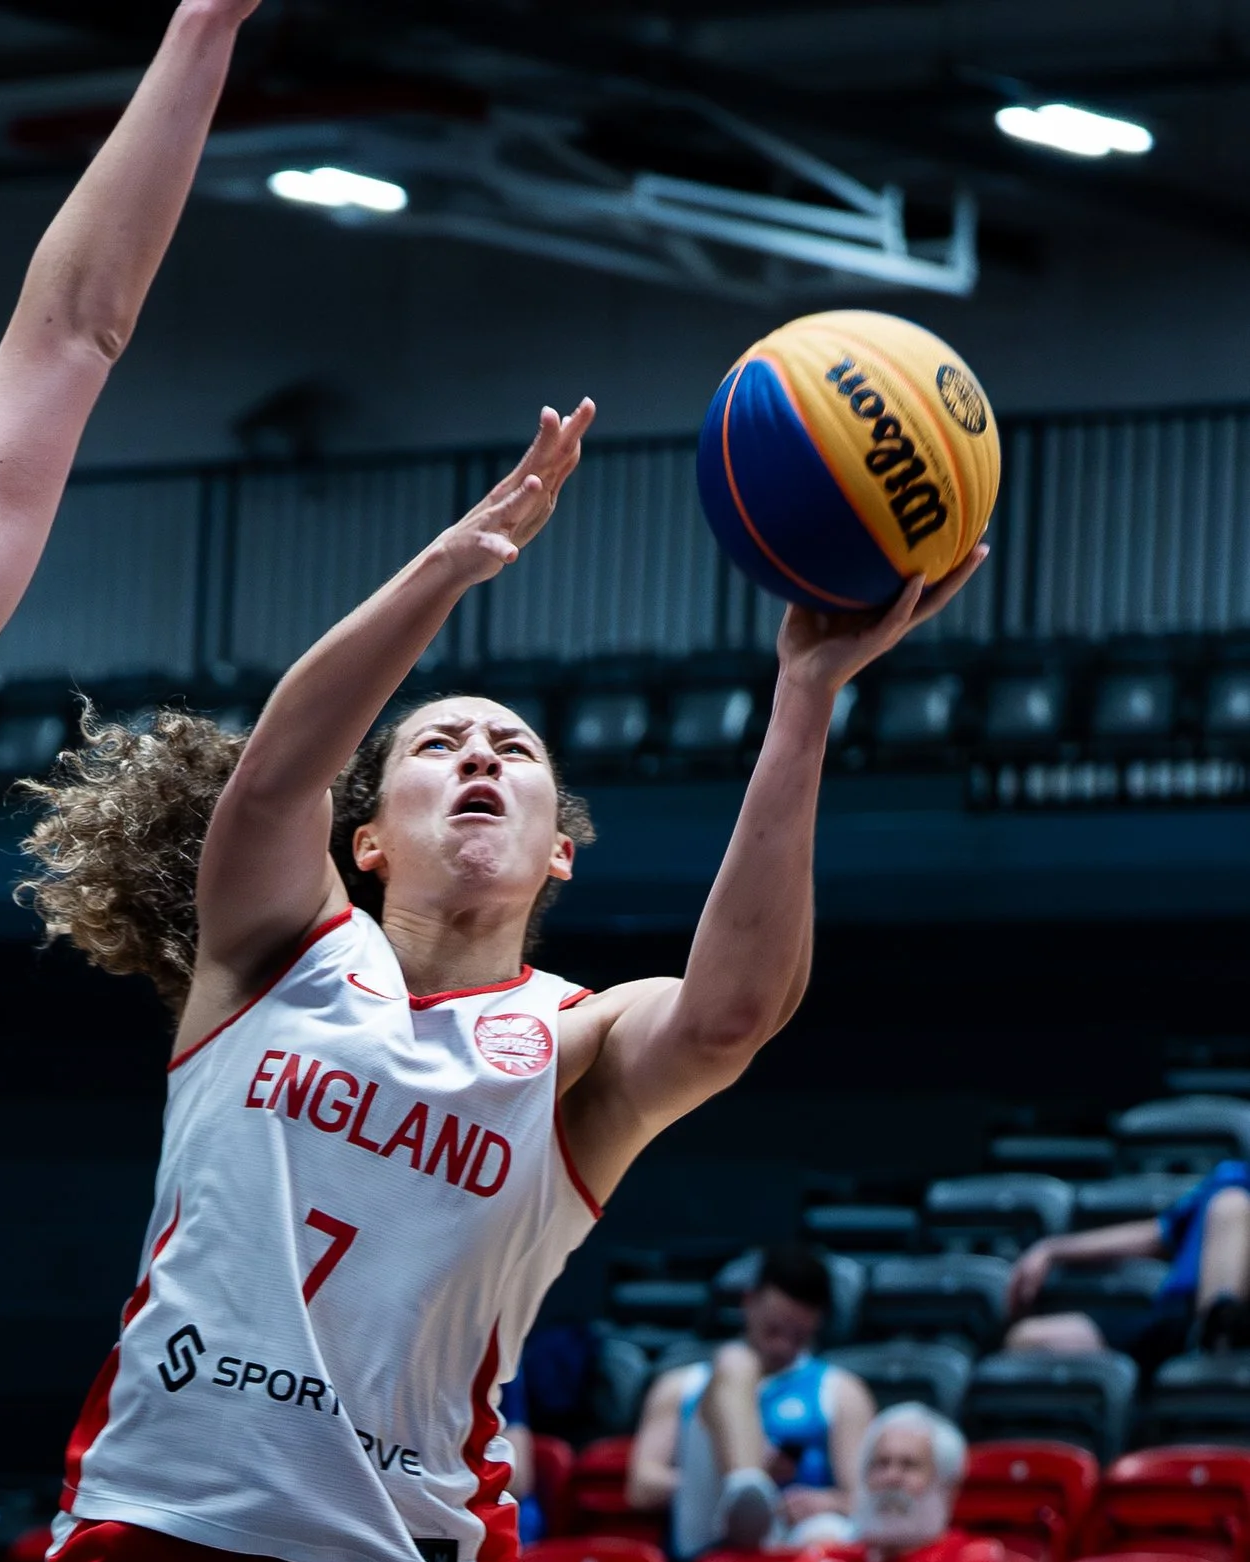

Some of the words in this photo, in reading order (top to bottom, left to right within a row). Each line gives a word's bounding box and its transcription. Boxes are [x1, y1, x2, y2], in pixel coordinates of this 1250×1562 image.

[824, 354, 948, 554] Wilson
[244, 1049, 513, 1198] ENGLAND
[303, 1208, 358, 1306] 7
[212, 1356, 422, 1476] SPORTRVE
